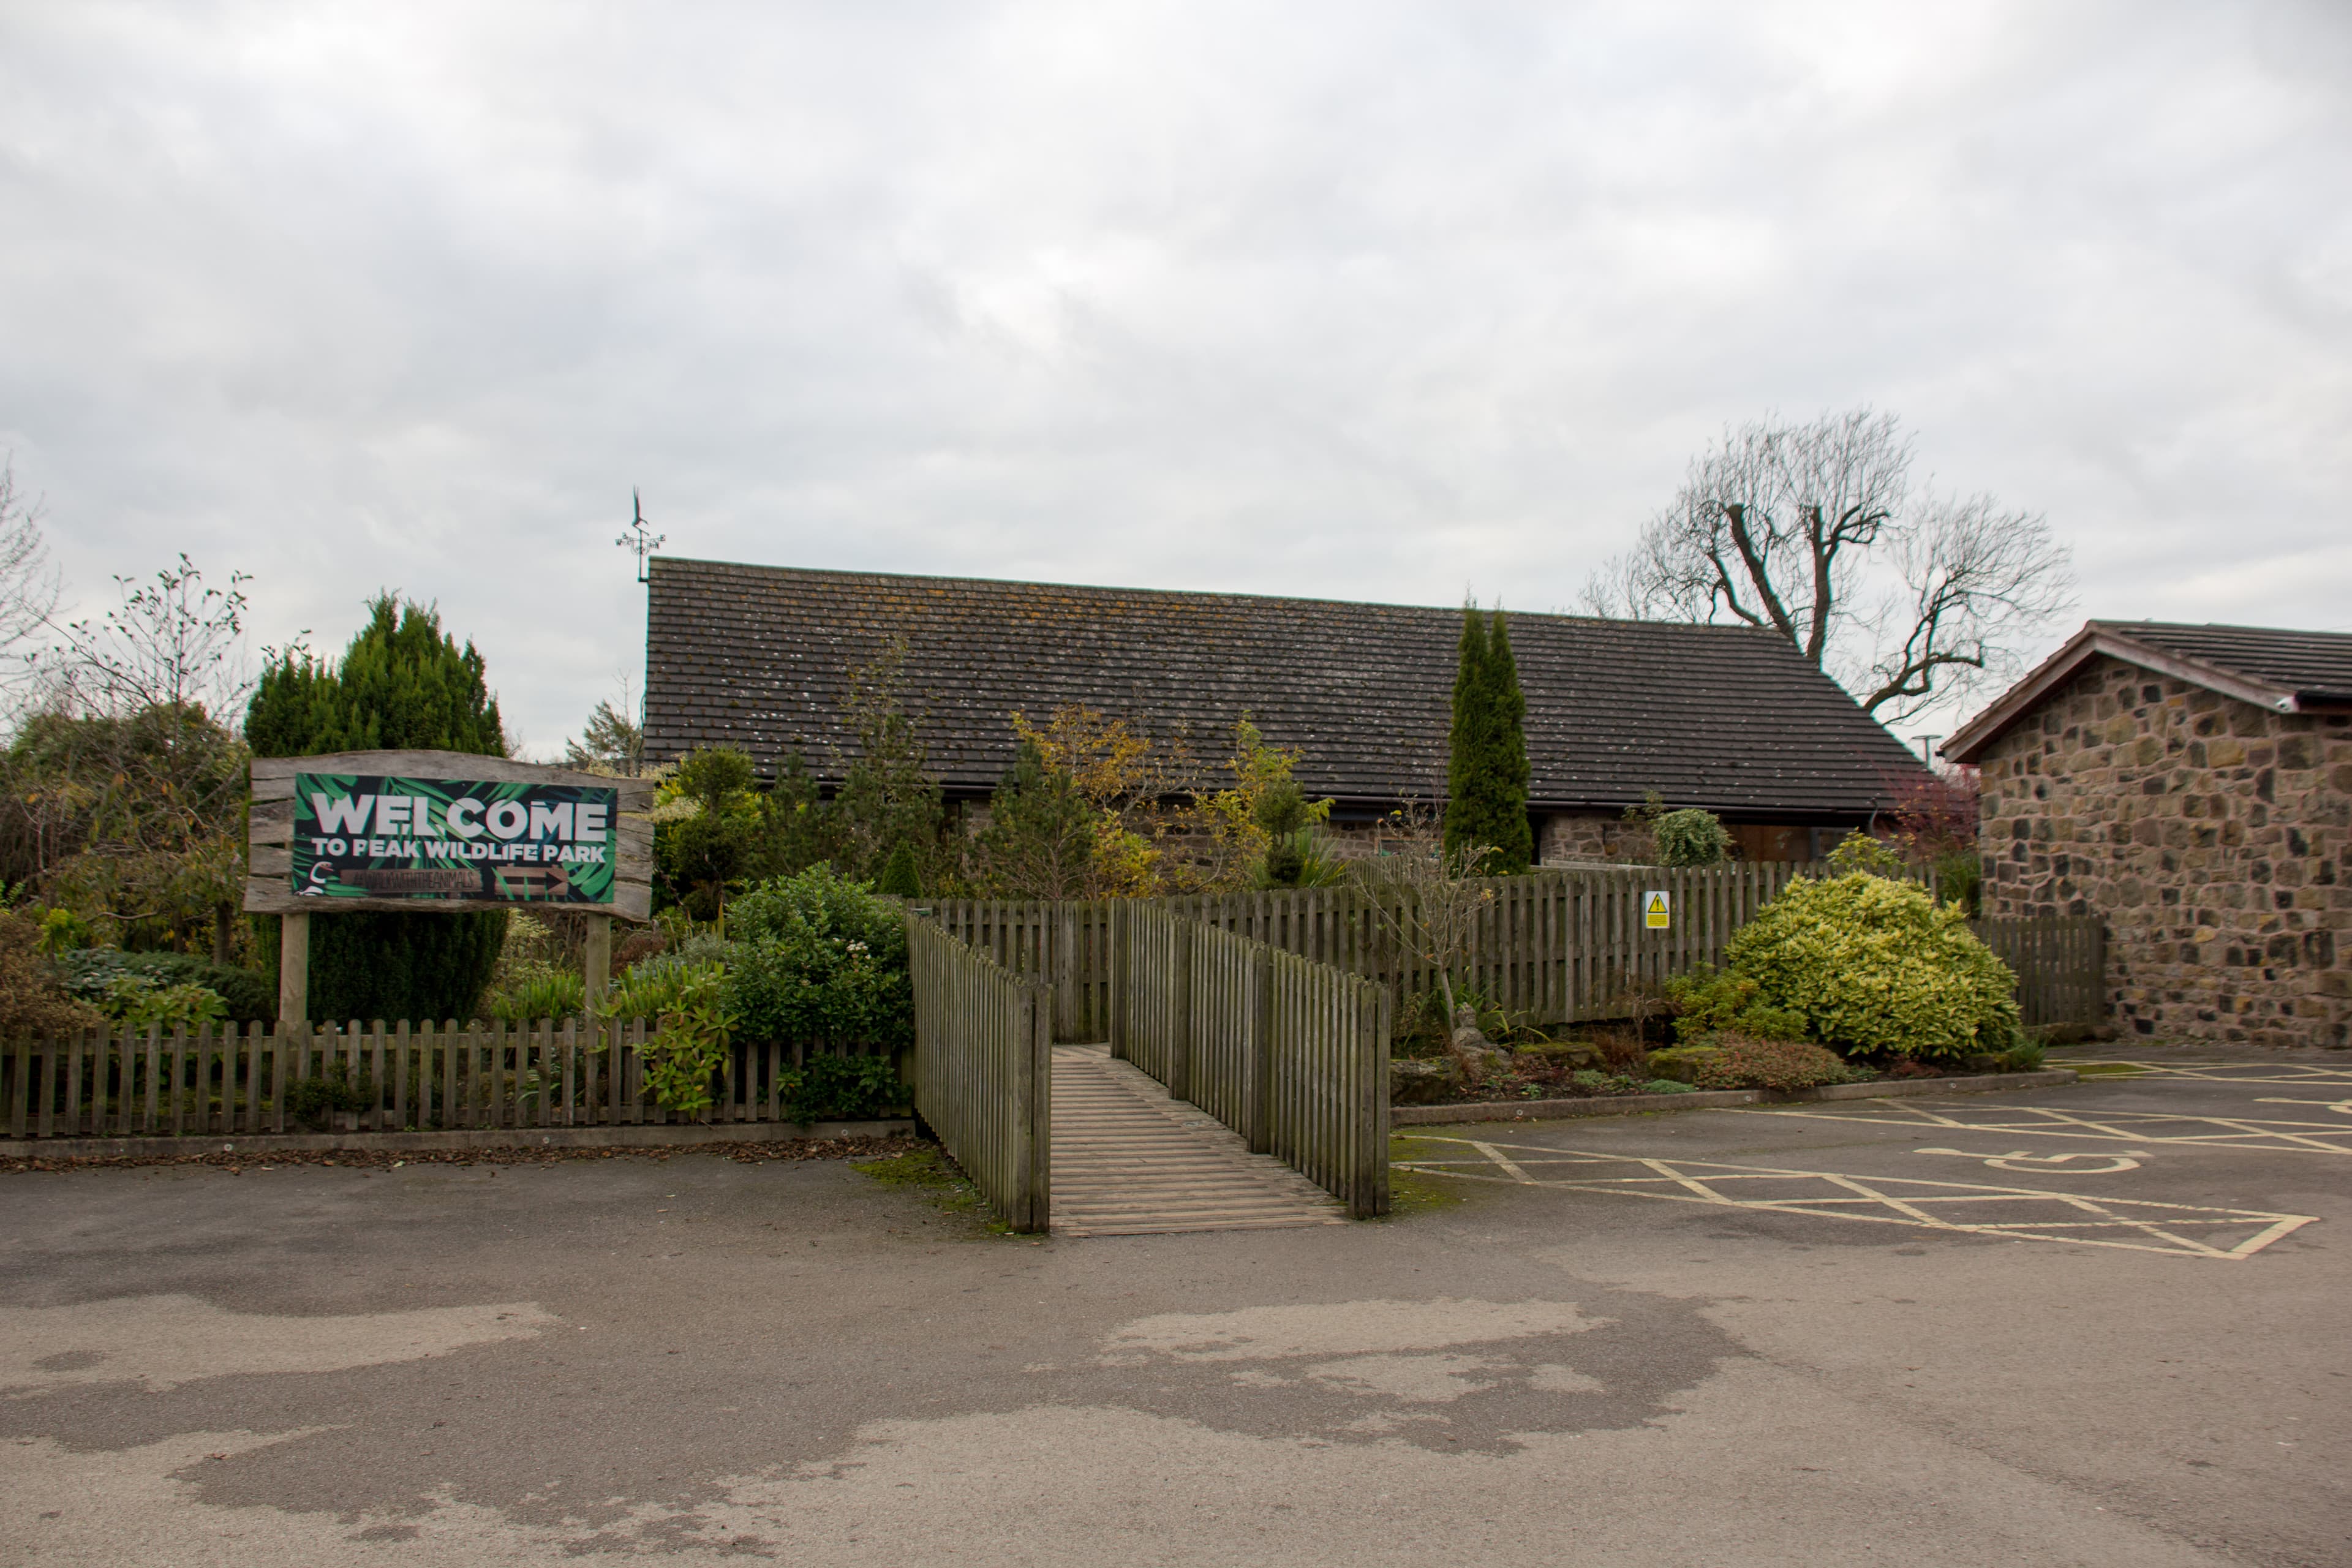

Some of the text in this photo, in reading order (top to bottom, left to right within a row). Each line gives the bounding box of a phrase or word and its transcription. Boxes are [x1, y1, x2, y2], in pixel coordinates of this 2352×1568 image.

[311, 793, 608, 842] WELCOME
[311, 837, 607, 863] TO PEAK WILDLIFE PARK
